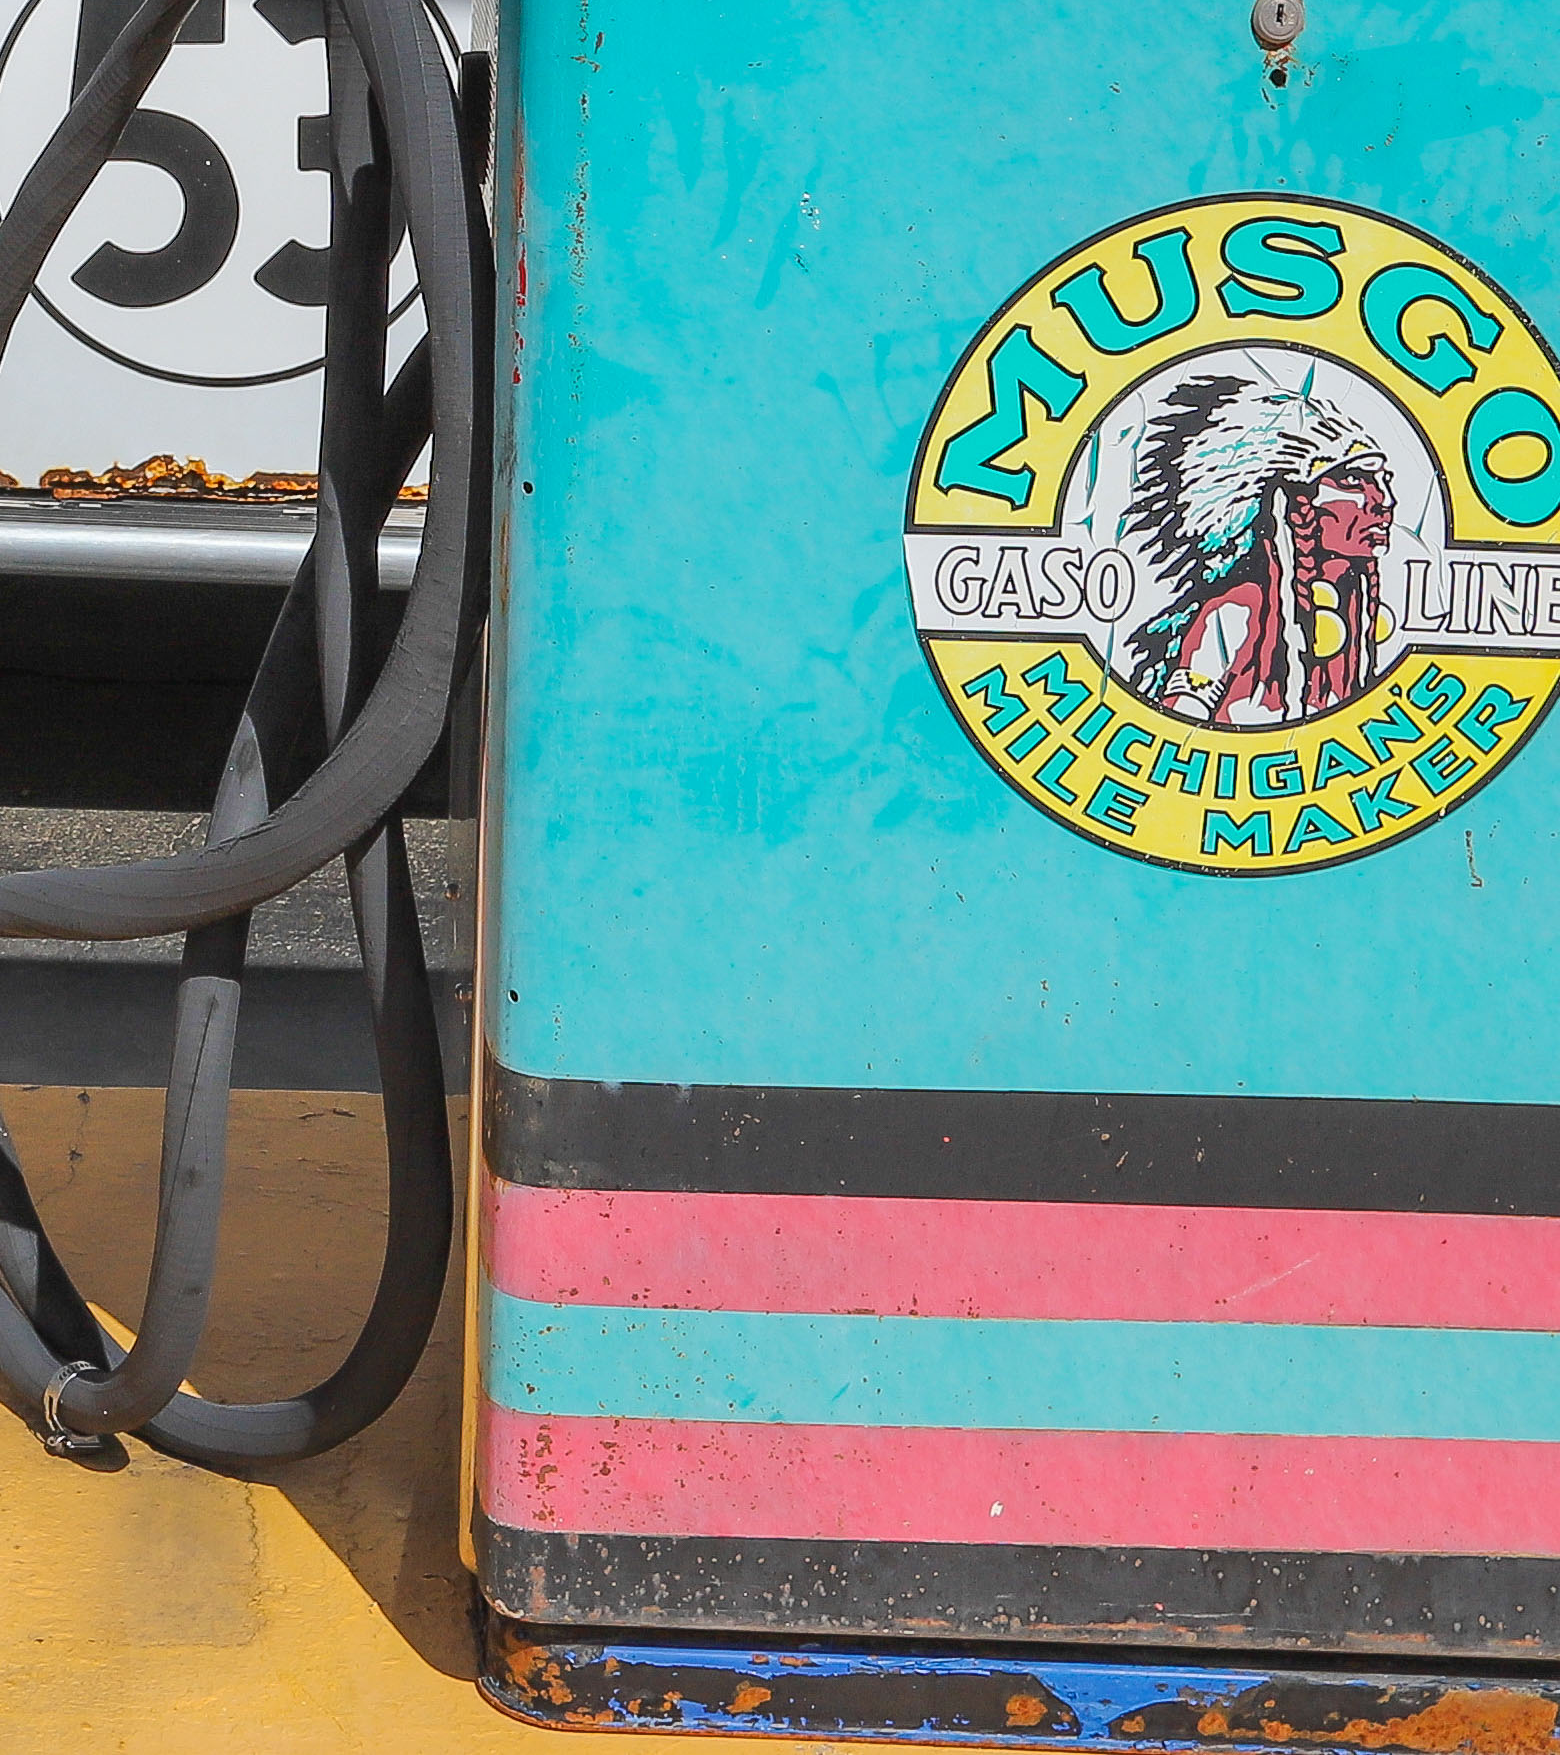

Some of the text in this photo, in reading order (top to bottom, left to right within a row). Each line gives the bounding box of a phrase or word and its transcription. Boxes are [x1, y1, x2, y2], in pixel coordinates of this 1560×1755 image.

[935, 546, 1137, 621] GASO
[963, 669, 1531, 858] MILE MAKER
[1020, 650, 1470, 802] MICHIGAN'S
